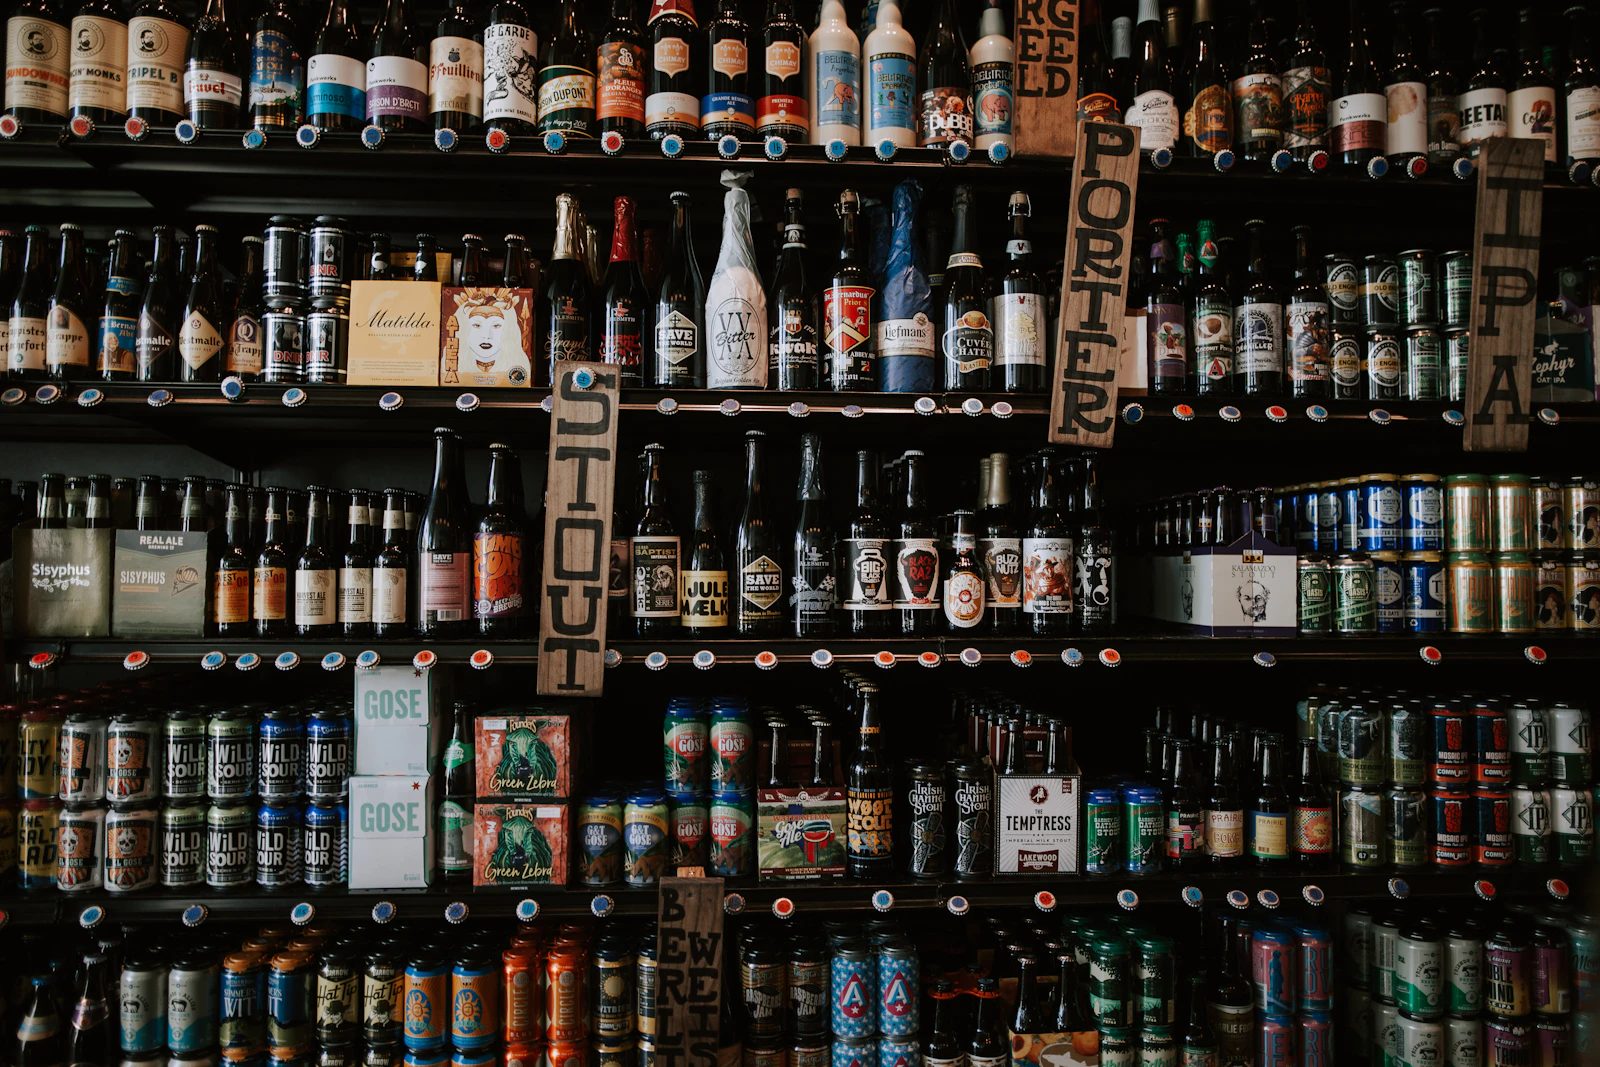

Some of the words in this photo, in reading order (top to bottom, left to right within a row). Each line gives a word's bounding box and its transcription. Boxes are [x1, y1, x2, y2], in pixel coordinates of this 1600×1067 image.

[486, 28, 495, 38] DE
[498, 25, 530, 41] GARDE
[718, 57, 745, 65] CHIMAY
[769, 59, 797, 67] CHIMAY
[86, 69, 121, 83] MONKS
[127, 67, 165, 80] TRIPEL
[170, 71, 178, 83] B
[553, 88, 587, 101] DUPONT
[1057, 122, 1134, 435] PORTER
[355, 309, 434, 329] Matilda
[657, 329, 693, 341] SAVE
[715, 331, 756, 348] Bitter
[883, 323, 928, 341] Liefmans
[444, 315, 460, 384] ATHENA
[139, 535, 164, 545] REAL
[166, 536, 184, 546] ALE
[861, 561, 881, 573] BIG
[996, 553, 1020, 565] BUZZ
[31, 563, 91, 578] Sisyphus
[995, 563, 1020, 575] NUTZ
[120, 571, 166, 584] SISYPHUS
[236, 576, 248, 587] 08
[273, 573, 285, 583] 09
[746, 573, 780, 586] SAVE
[687, 582, 728, 598] JULE
[363, 689, 422, 719] GOSE
[214, 743, 254, 763] WiLD
[262, 742, 299, 762] WiLD
[678, 738, 705, 753] GOSE
[717, 738, 745, 752] GOSE
[1438, 751, 1459, 760] MOSAIC
[167, 763, 205, 778] SOUR
[215, 763, 254, 778] SOUR
[262, 762, 299, 778] SOUR
[489, 772, 525, 791] Green
[526, 774, 558, 791] Zebra
[20, 815, 44, 828] THE
[359, 802, 420, 832] GOSE
[771, 813, 832, 821] WATERMELON
[1005, 816, 1071, 831] TEMPTRESS
[586, 825, 605, 835] G&T
[630, 825, 649, 835] G&T
[676, 823, 704, 837] GOSE
[710, 822, 738, 837] GOSE
[775, 820, 805, 839] Gose
[161, 831, 201, 850] WiLD
[209, 831, 248, 850] WiLD
[584, 834, 608, 846] GOSE
[628, 834, 652, 845] GOSE
[780, 829, 803, 849] Ale
[161, 851, 200, 867] SOUR
[209, 851, 248, 867] SOUR
[1018, 854, 1057, 862] LAKEWOOD
[484, 862, 520, 880] Green
[521, 863, 552, 880] Zebra
[340, 980, 358, 1000] Tip
[386, 980, 403, 998] Tip
[841, 980, 867, 1007] A
[885, 979, 912, 1006] A
[223, 995, 257, 1017] WIT
[512, 987, 526, 1028] CIRCLE
[558, 985, 576, 1027] CIRCLE
[752, 1000, 773, 1019] JAM
[796, 1000, 817, 1017] JAM
